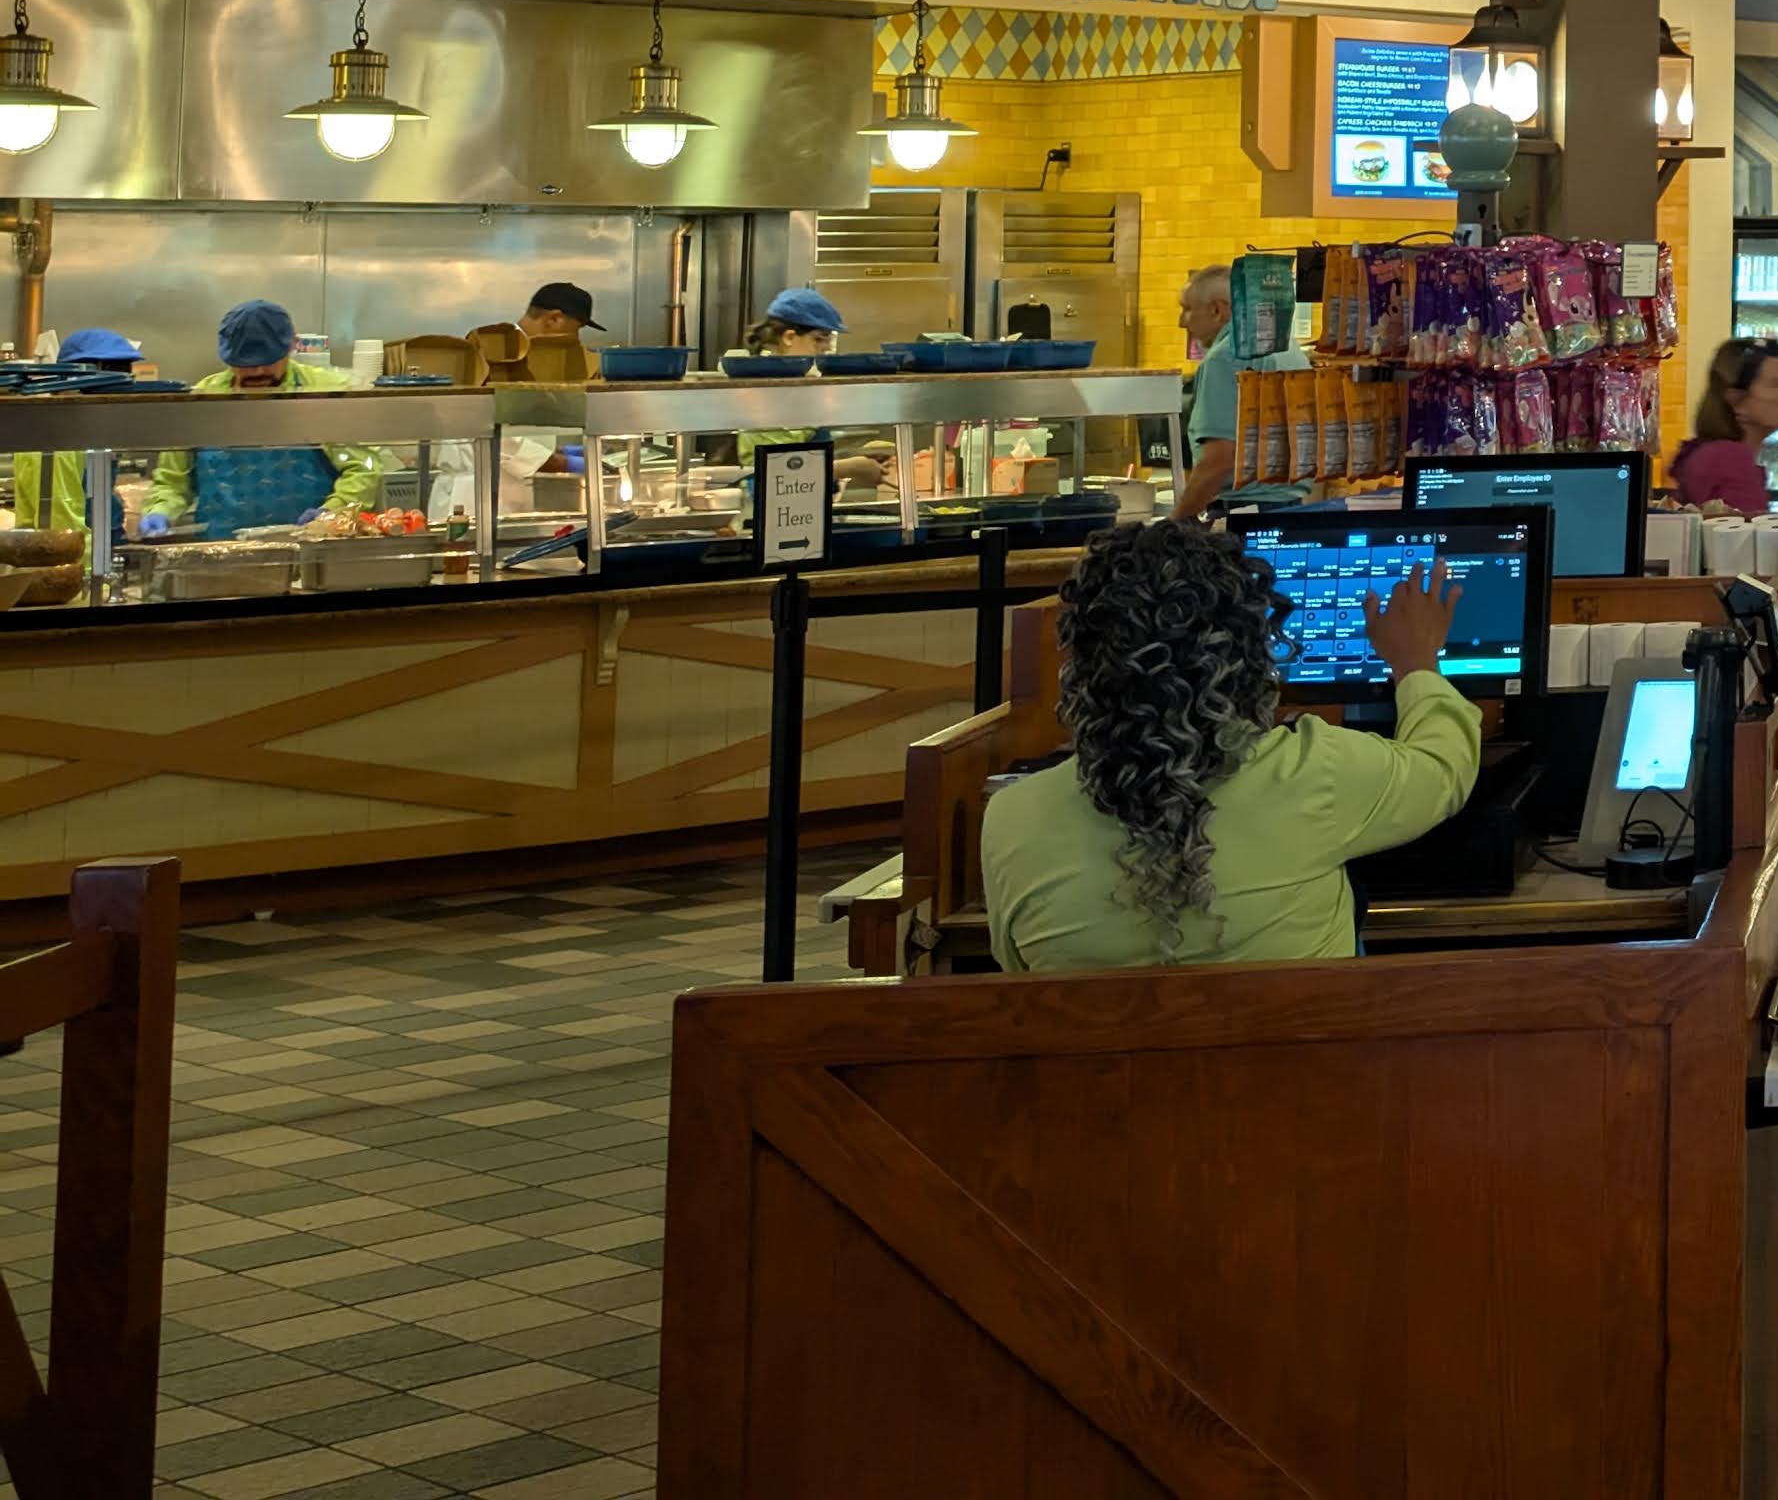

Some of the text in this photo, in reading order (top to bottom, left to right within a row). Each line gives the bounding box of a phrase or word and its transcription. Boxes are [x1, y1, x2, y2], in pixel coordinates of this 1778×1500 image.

[1376, 64, 1400, 73] BURGER
[1337, 79, 1406, 90] BACON CHEESEBURGER
[1337, 96, 1382, 105] KOREAN-STYLE
[1421, 99, 1445, 107] BURGER
[1337, 118, 1424, 127] CAPRESE CHICKEN SANDWICH
[1496, 474, 1552, 484] Enter Employee ID
[776, 475, 816, 496] Enter
[777, 506, 814, 527] Here
